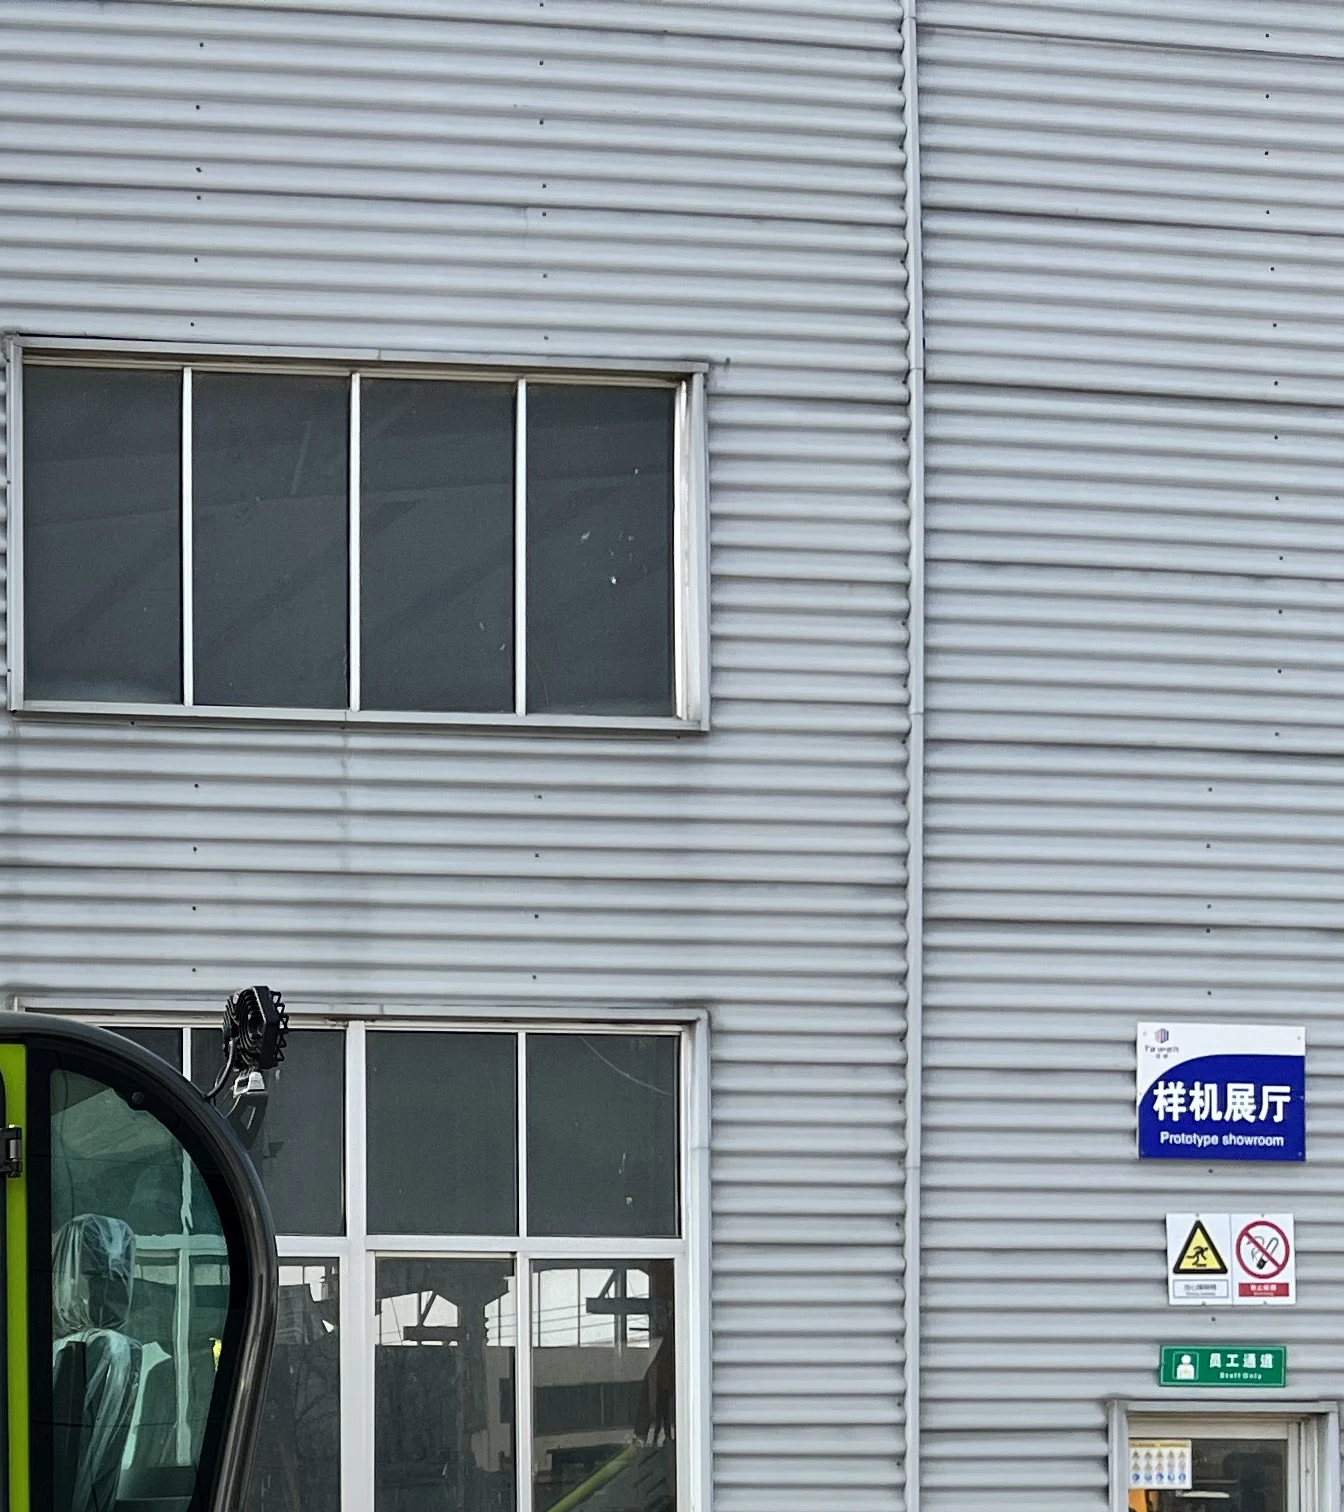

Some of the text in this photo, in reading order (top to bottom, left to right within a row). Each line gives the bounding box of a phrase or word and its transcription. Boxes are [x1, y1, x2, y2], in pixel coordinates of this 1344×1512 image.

[1153, 1080, 1292, 1123] 样机展厅
[1160, 1131, 1285, 1148] Prototype showroom
